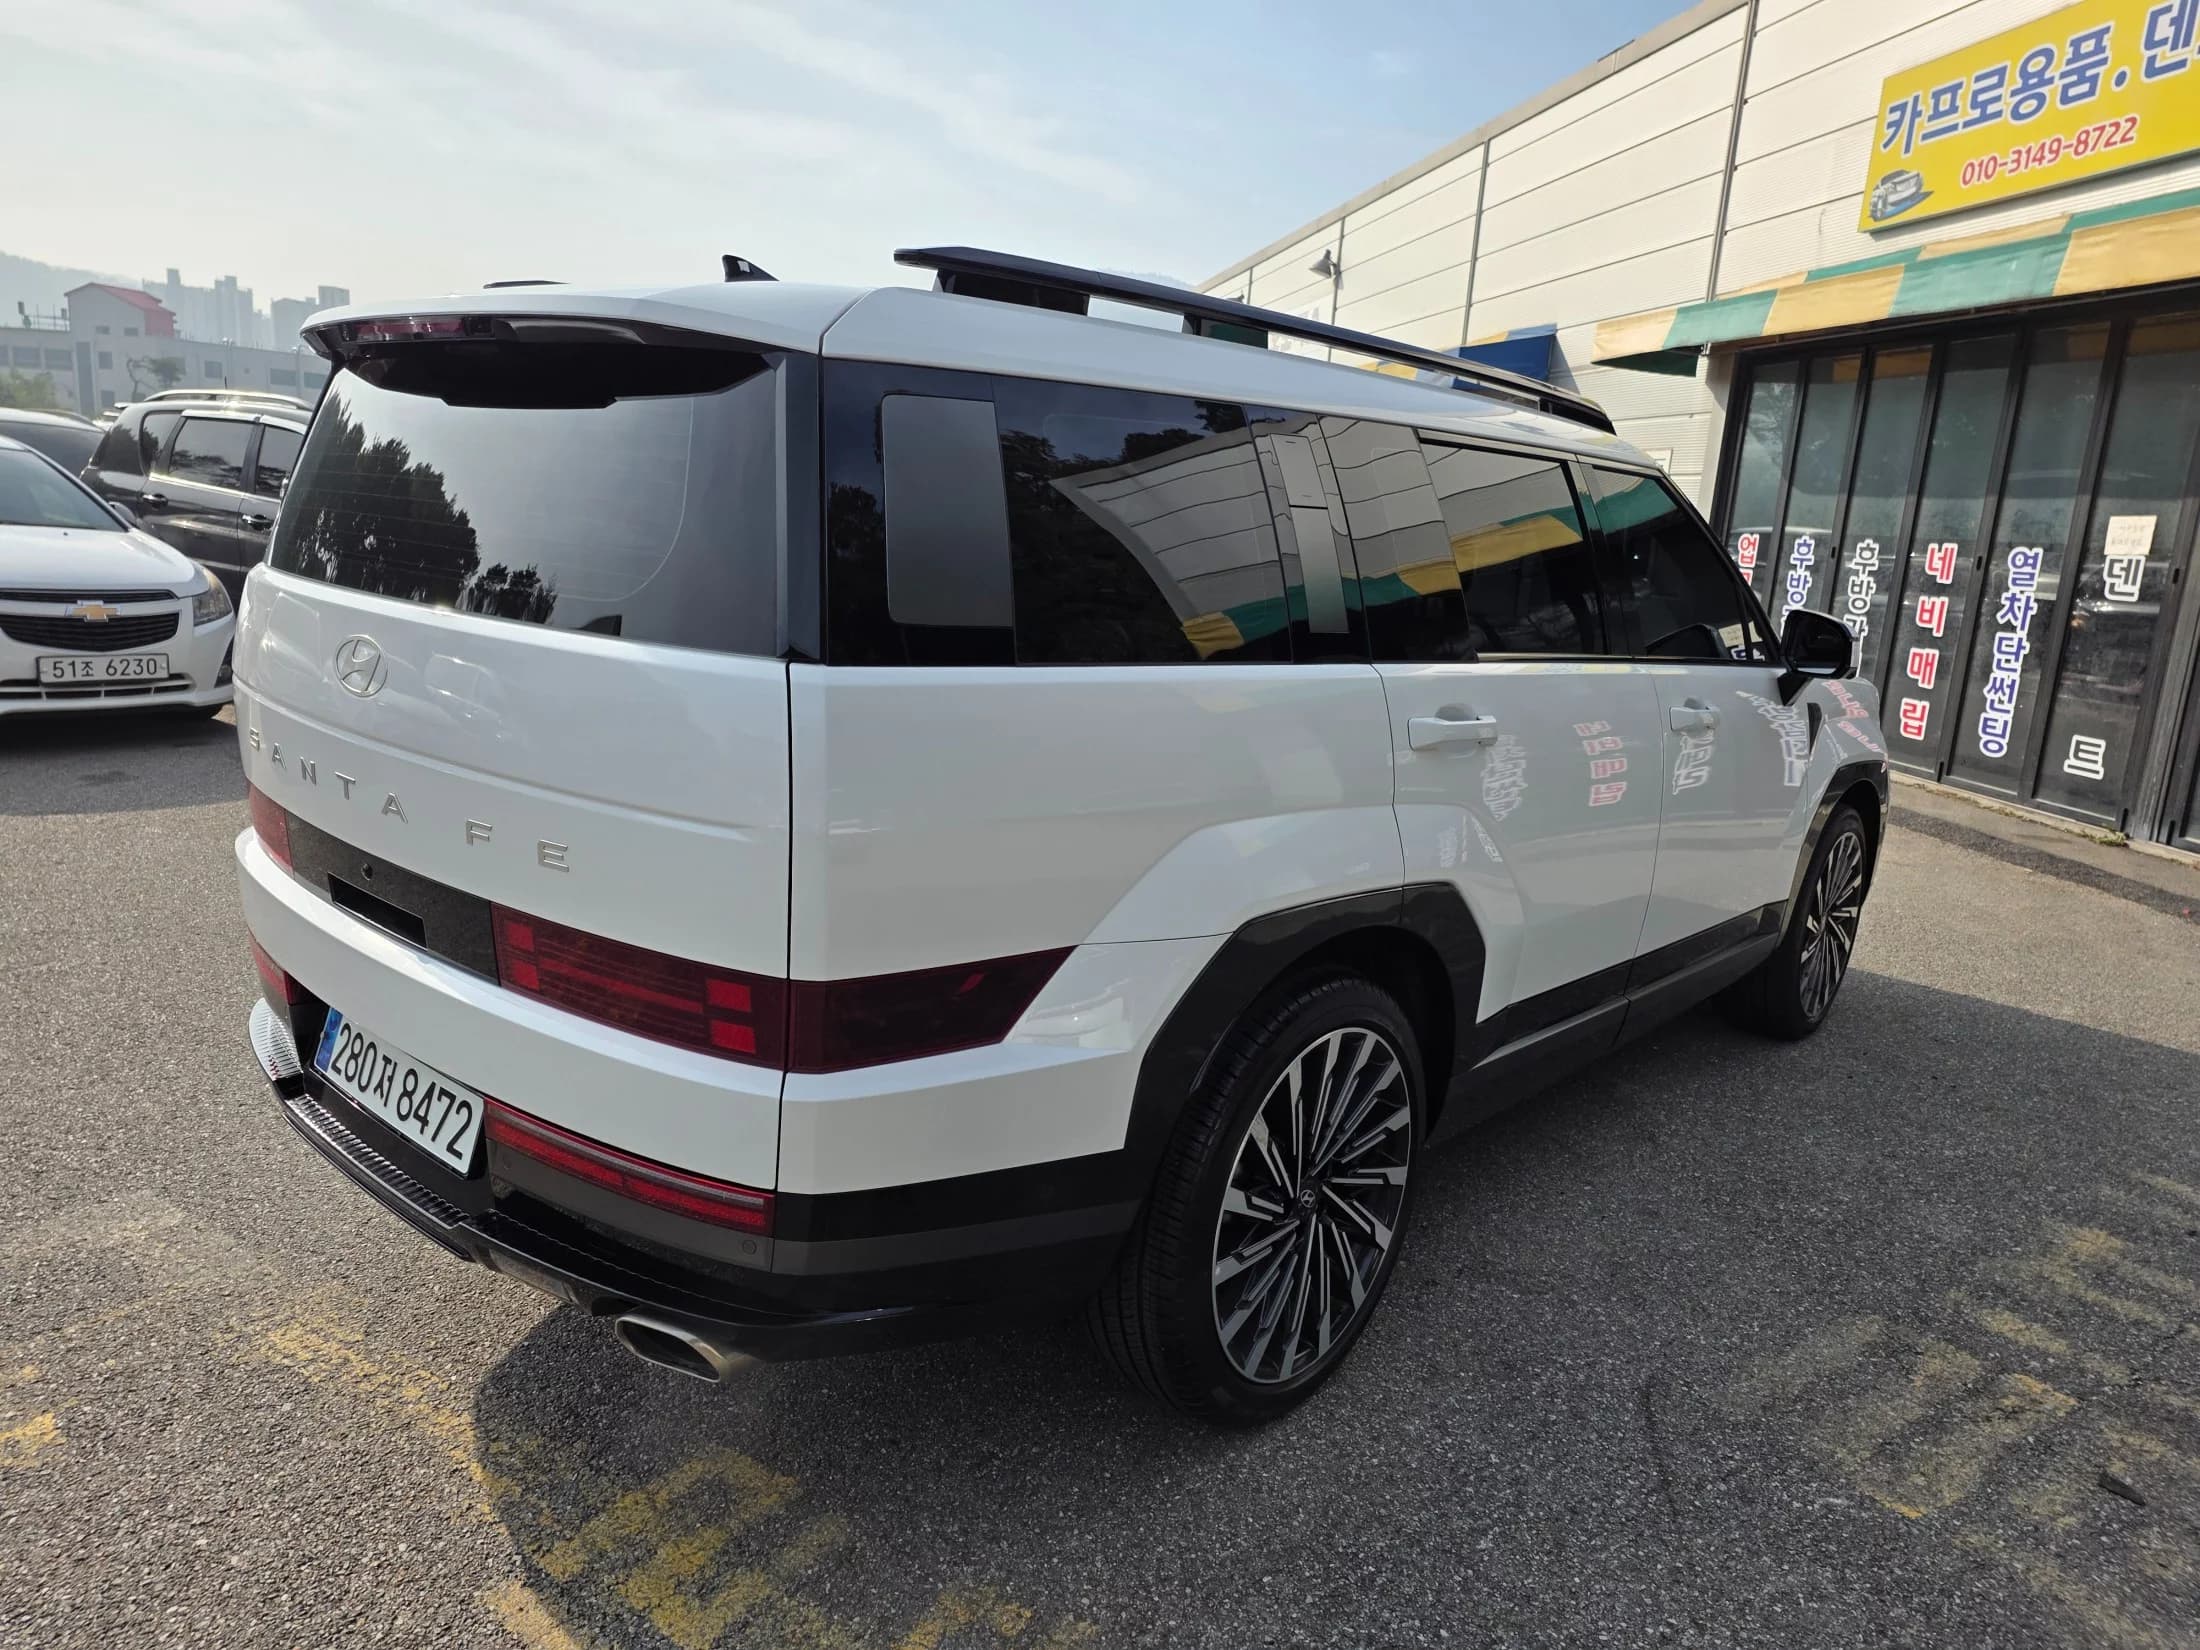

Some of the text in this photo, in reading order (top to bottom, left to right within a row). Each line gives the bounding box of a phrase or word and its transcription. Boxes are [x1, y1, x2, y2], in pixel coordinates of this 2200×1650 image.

[1960, 115, 2139, 187] 010-3149-8722
[52, 658, 158, 679] 51조 6230
[1900, 543, 1958, 740] 네비매립
[1979, 547, 2044, 757] 열차단썬팅
[249, 727, 570, 873] SANTA FE
